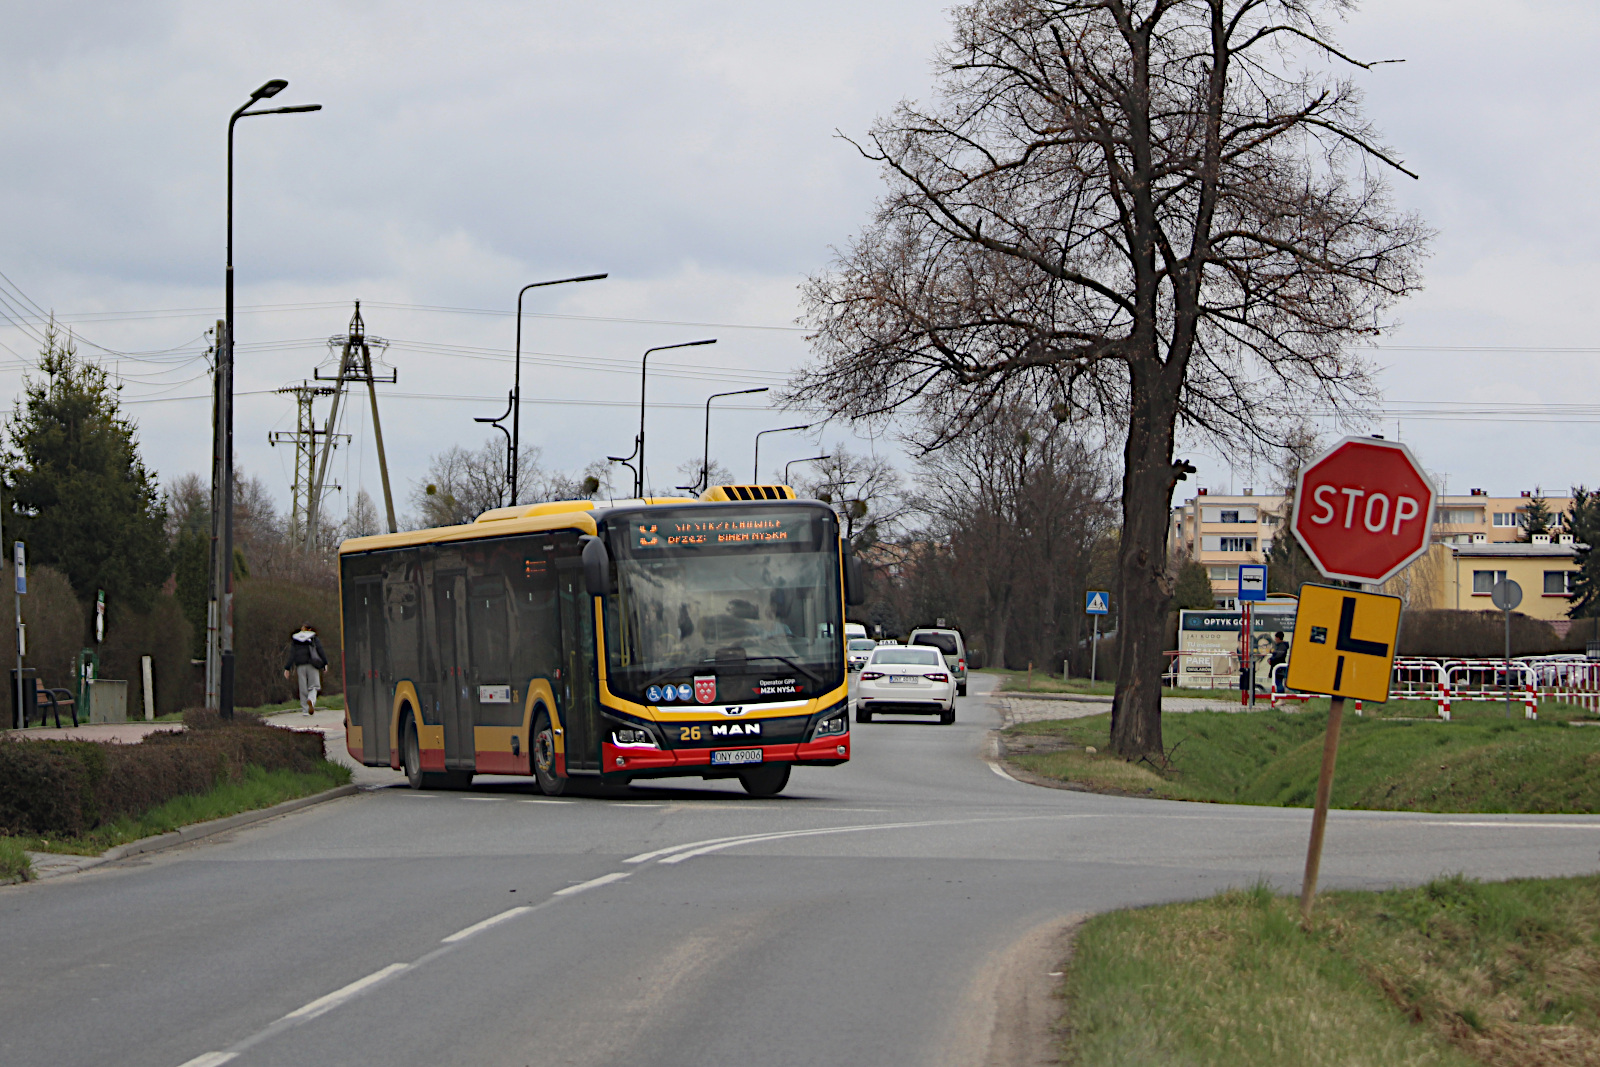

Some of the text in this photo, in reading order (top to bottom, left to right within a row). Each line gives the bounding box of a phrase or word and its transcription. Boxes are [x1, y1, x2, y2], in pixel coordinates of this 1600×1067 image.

[1310, 484, 1419, 536] STOP
[1203, 618, 1232, 626] OPTYK
[1232, 616, 1264, 626] GÓKI
[776, 685, 796, 693] NYSA
[680, 726, 701, 741] 26
[712, 723, 760, 735] MAN
[715, 750, 761, 762] ONY 69006
